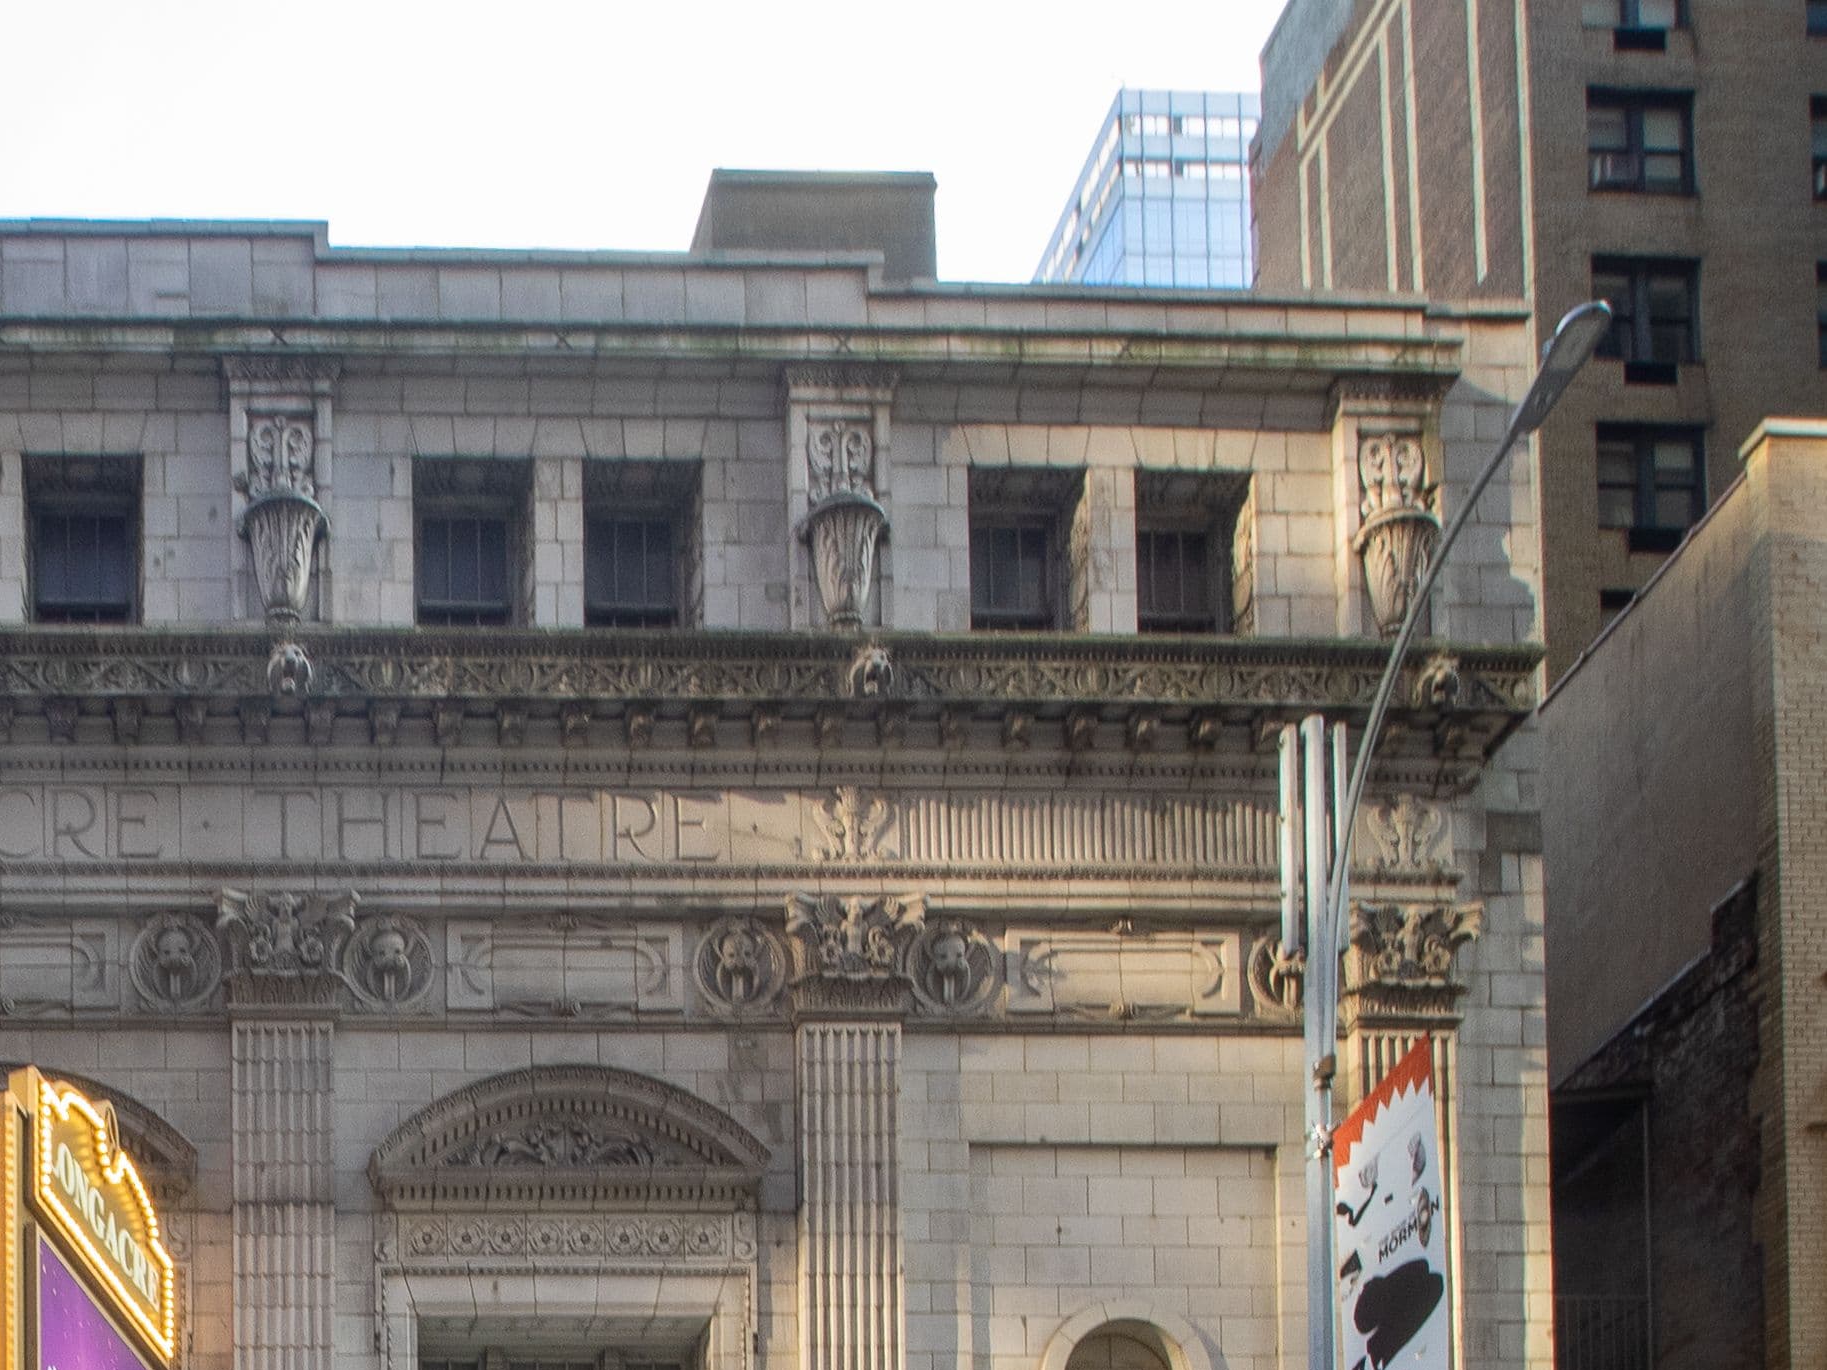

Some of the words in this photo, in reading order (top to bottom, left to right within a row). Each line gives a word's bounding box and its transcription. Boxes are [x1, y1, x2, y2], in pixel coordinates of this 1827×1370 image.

[253, 788, 723, 860] THEATRE
[52, 1142, 160, 1312] ONGACRE
[1378, 1195, 1439, 1264] MORMN
